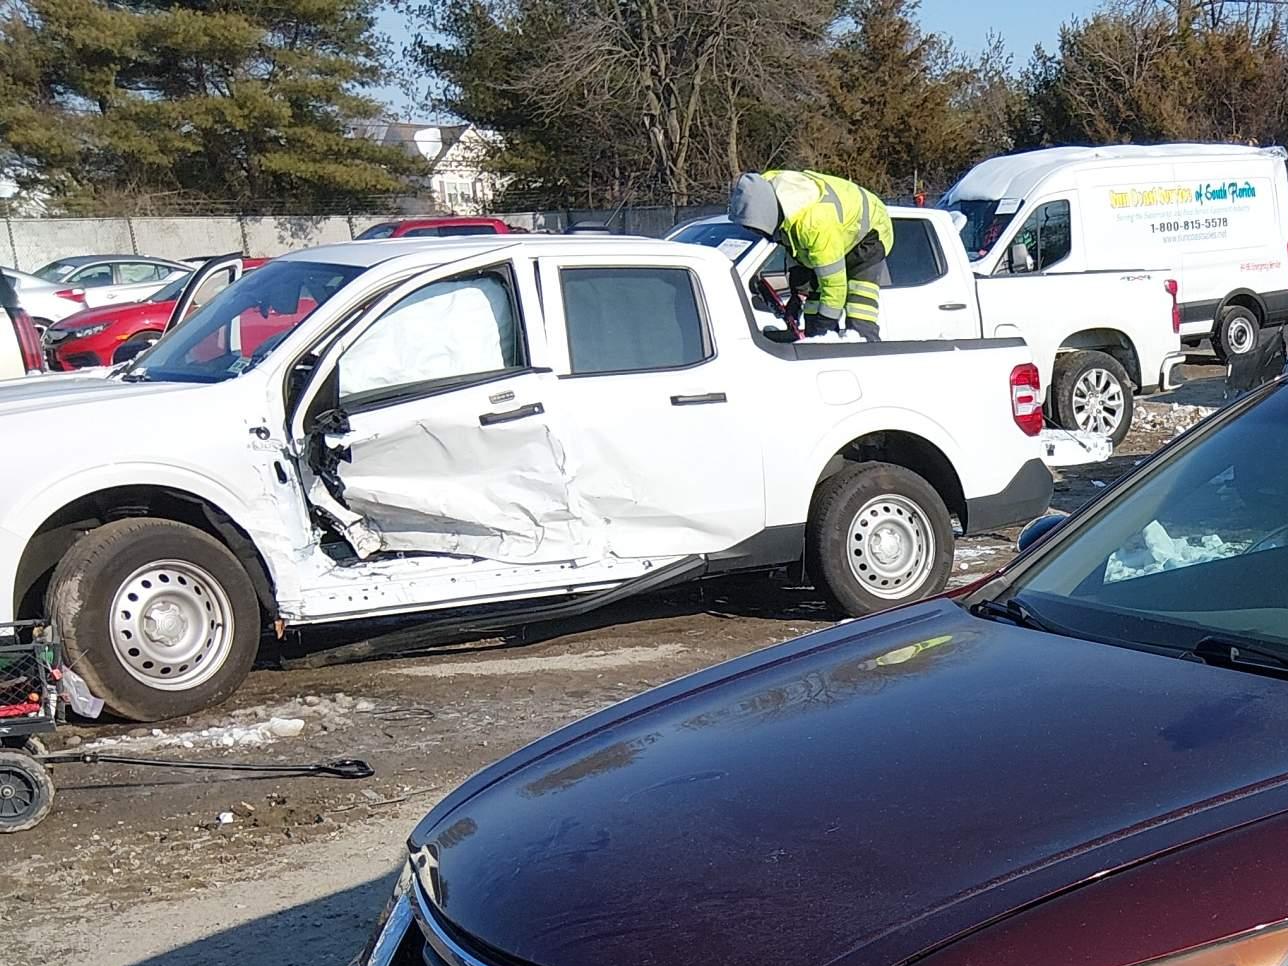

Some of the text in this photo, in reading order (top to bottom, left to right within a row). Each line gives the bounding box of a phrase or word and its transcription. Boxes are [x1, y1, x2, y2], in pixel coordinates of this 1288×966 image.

[1194, 184, 1203, 205] of
[1205, 182, 1227, 200] South
[1228, 181, 1256, 203] Florida
[1150, 217, 1229, 233] 1-800-815-5578
